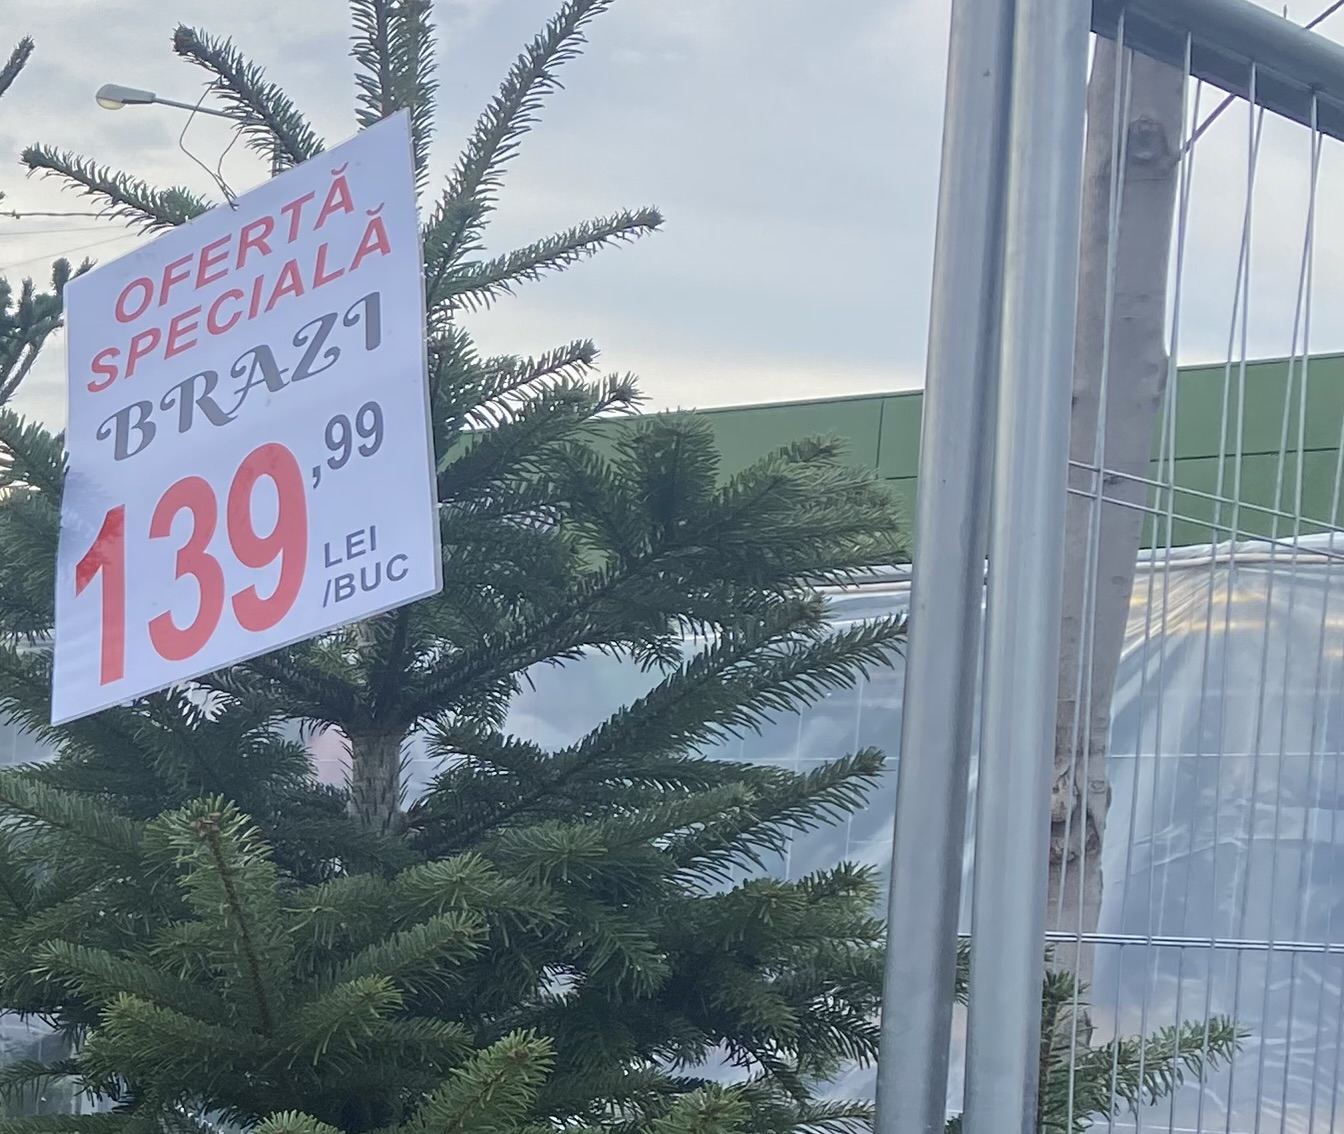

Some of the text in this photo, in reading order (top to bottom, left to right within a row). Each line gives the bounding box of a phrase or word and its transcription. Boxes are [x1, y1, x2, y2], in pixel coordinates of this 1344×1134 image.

[86, 203, 393, 394] SPECIALĂ
[113, 160, 356, 324] OFERTĂ
[96, 291, 383, 462] BRAZI
[322, 553, 410, 608] /BUC
[323, 525, 378, 568] LEI
